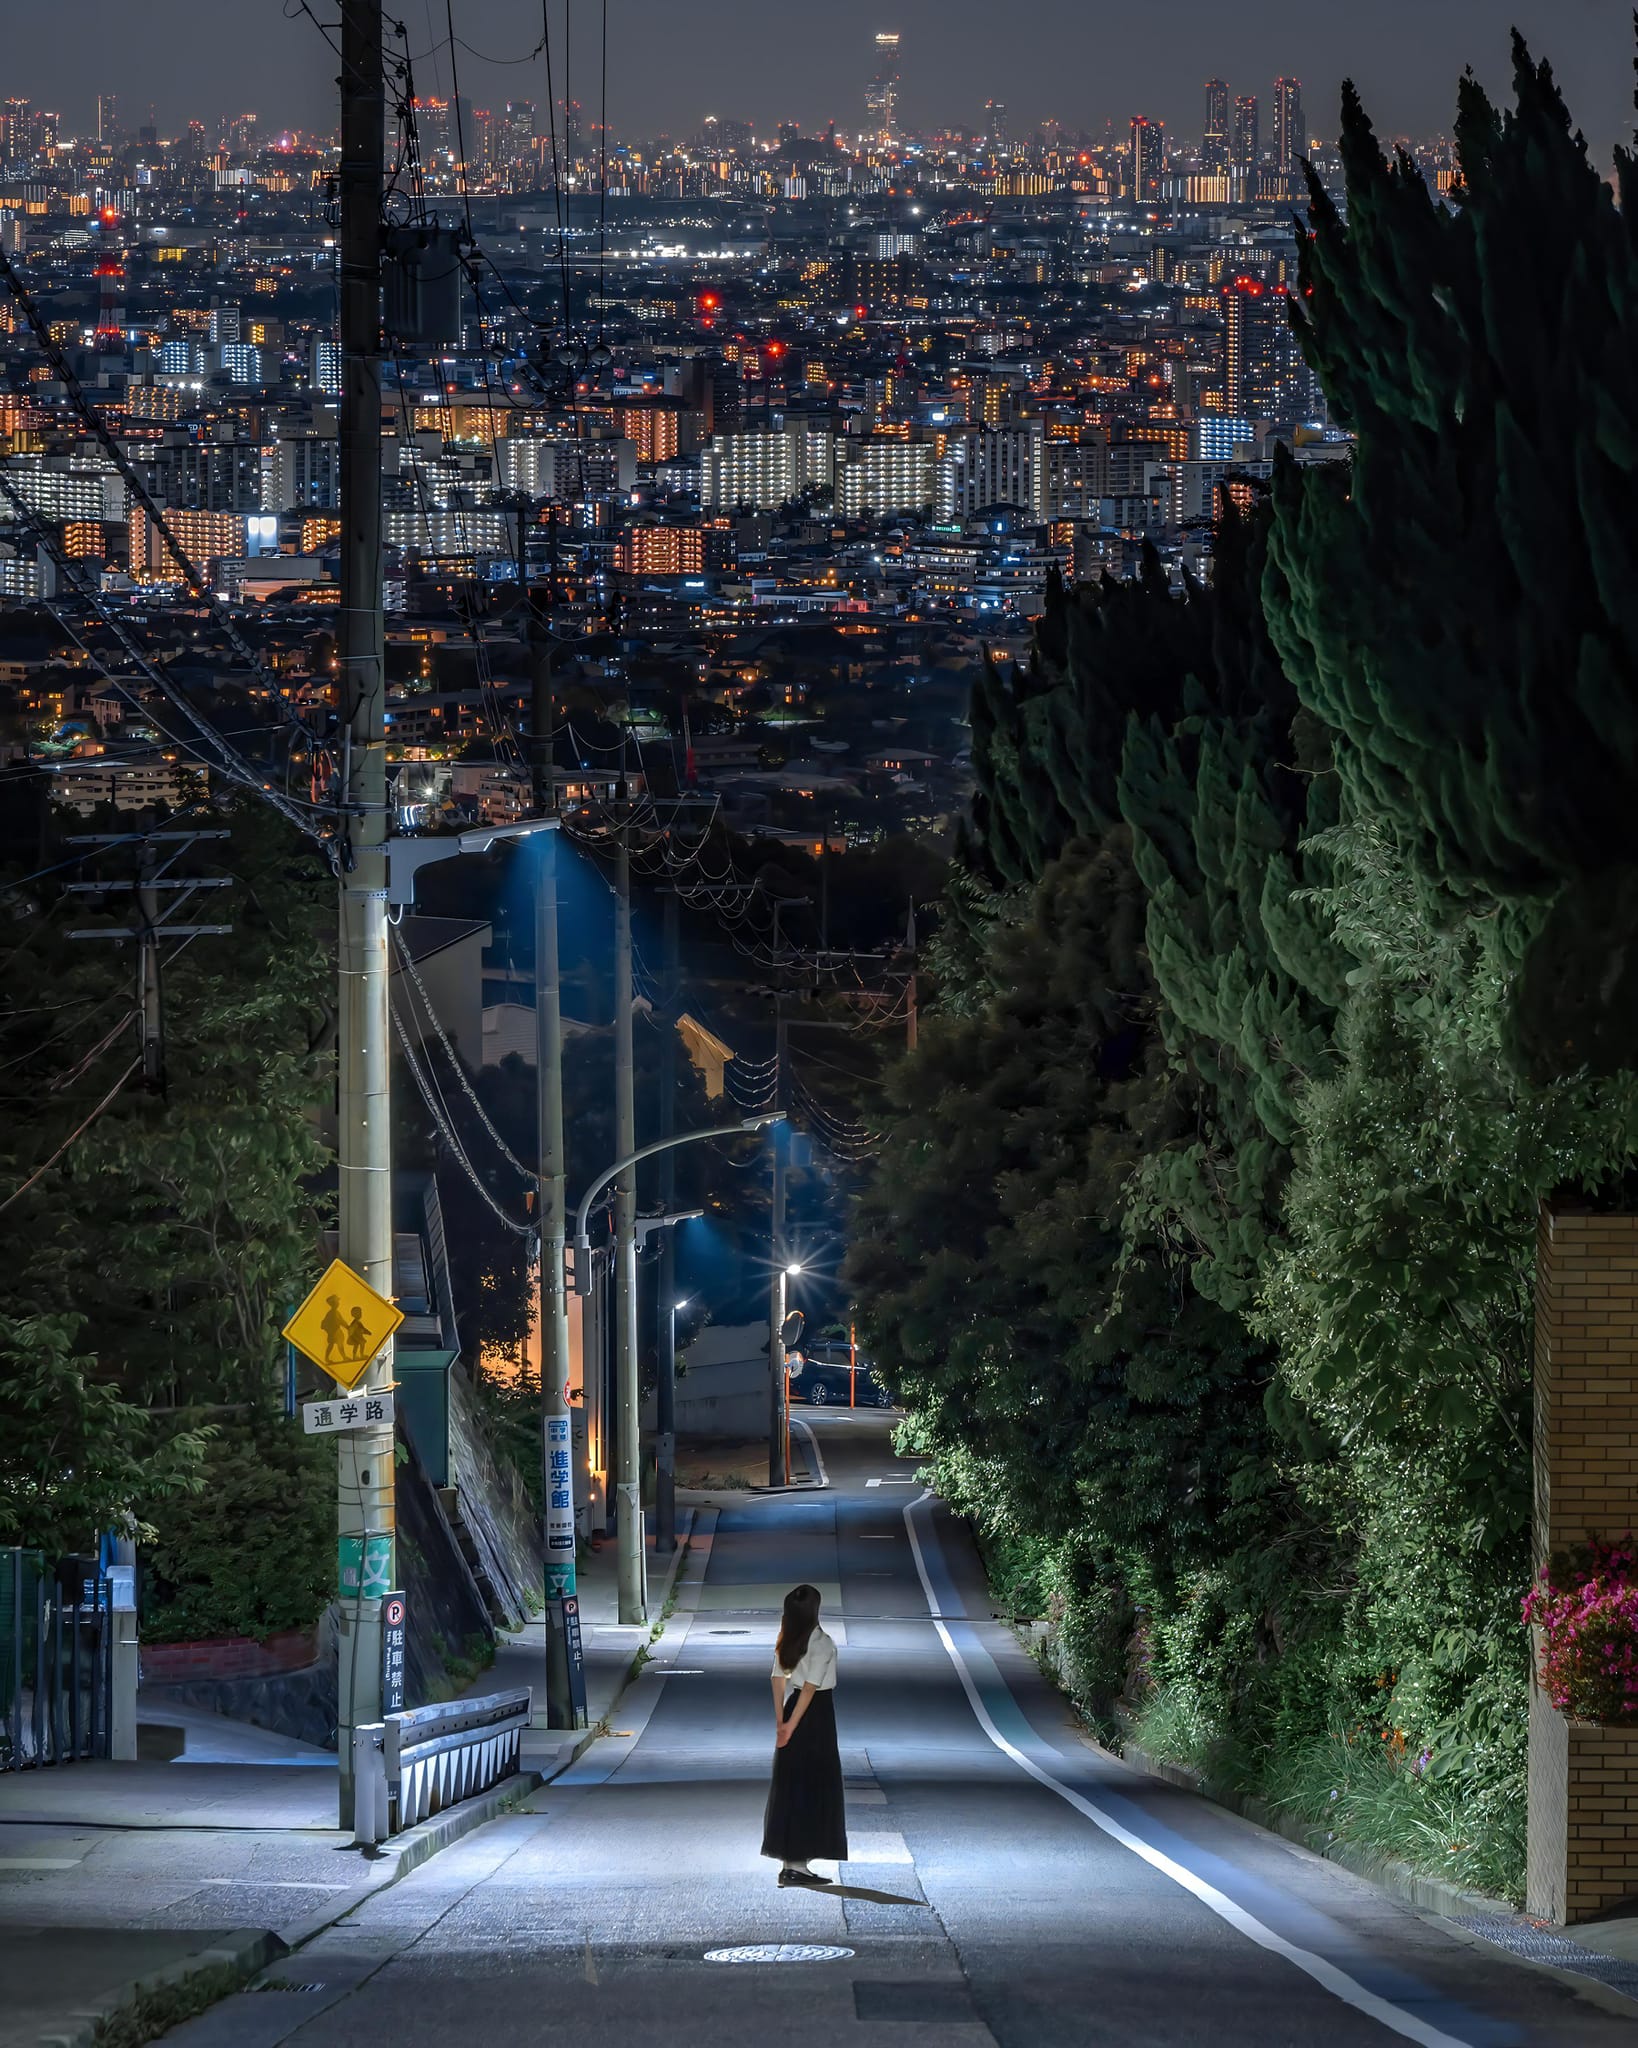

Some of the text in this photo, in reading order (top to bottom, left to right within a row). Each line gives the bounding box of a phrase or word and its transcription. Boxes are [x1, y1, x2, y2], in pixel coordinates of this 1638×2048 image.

[314, 1400, 384, 1427] 通学路
[550, 1450, 569, 1509] 進学館
[357, 1550, 390, 1587] 文
[391, 1629, 403, 1708] 駐車禁止
